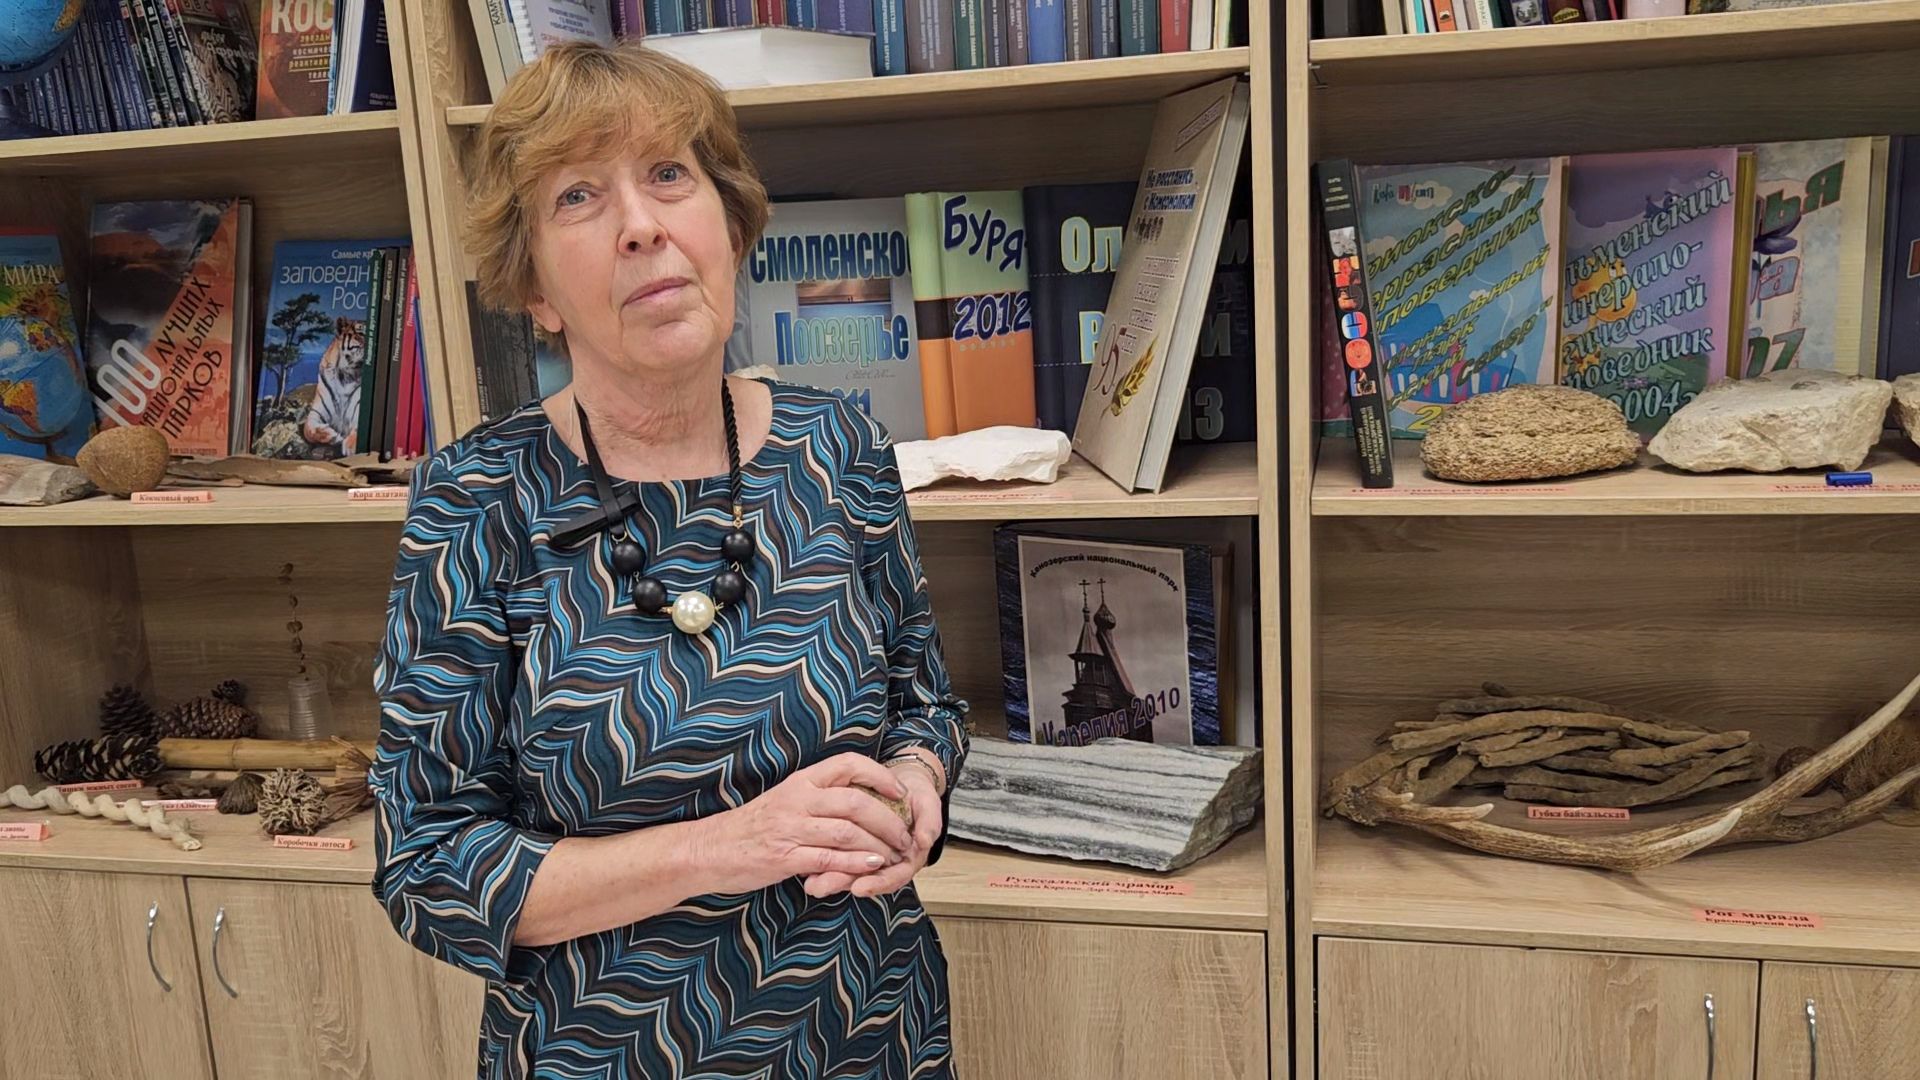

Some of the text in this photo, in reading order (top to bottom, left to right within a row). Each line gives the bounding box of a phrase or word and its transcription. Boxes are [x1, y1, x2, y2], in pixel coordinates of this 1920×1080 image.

[4, 264, 61, 286] МИРА
[331, 249, 362, 260] Самые
[751, 231, 913, 284] Смоленско
[154, 276, 212, 365] ЛУЧШИХ
[332, 286, 368, 310] Рос
[953, 291, 1033, 342] 2012
[138, 297, 225, 428] АЦИОНАЛЬНЫХ
[774, 311, 911, 368] Поозерье
[93, 338, 162, 428] 100
[160, 350, 223, 440] ПАРКОВ
[353, 489, 372, 499] Кора
[1029, 553, 1179, 592] Кенозерский национальный парк
[1704, 908, 1811, 922] Рог марала
